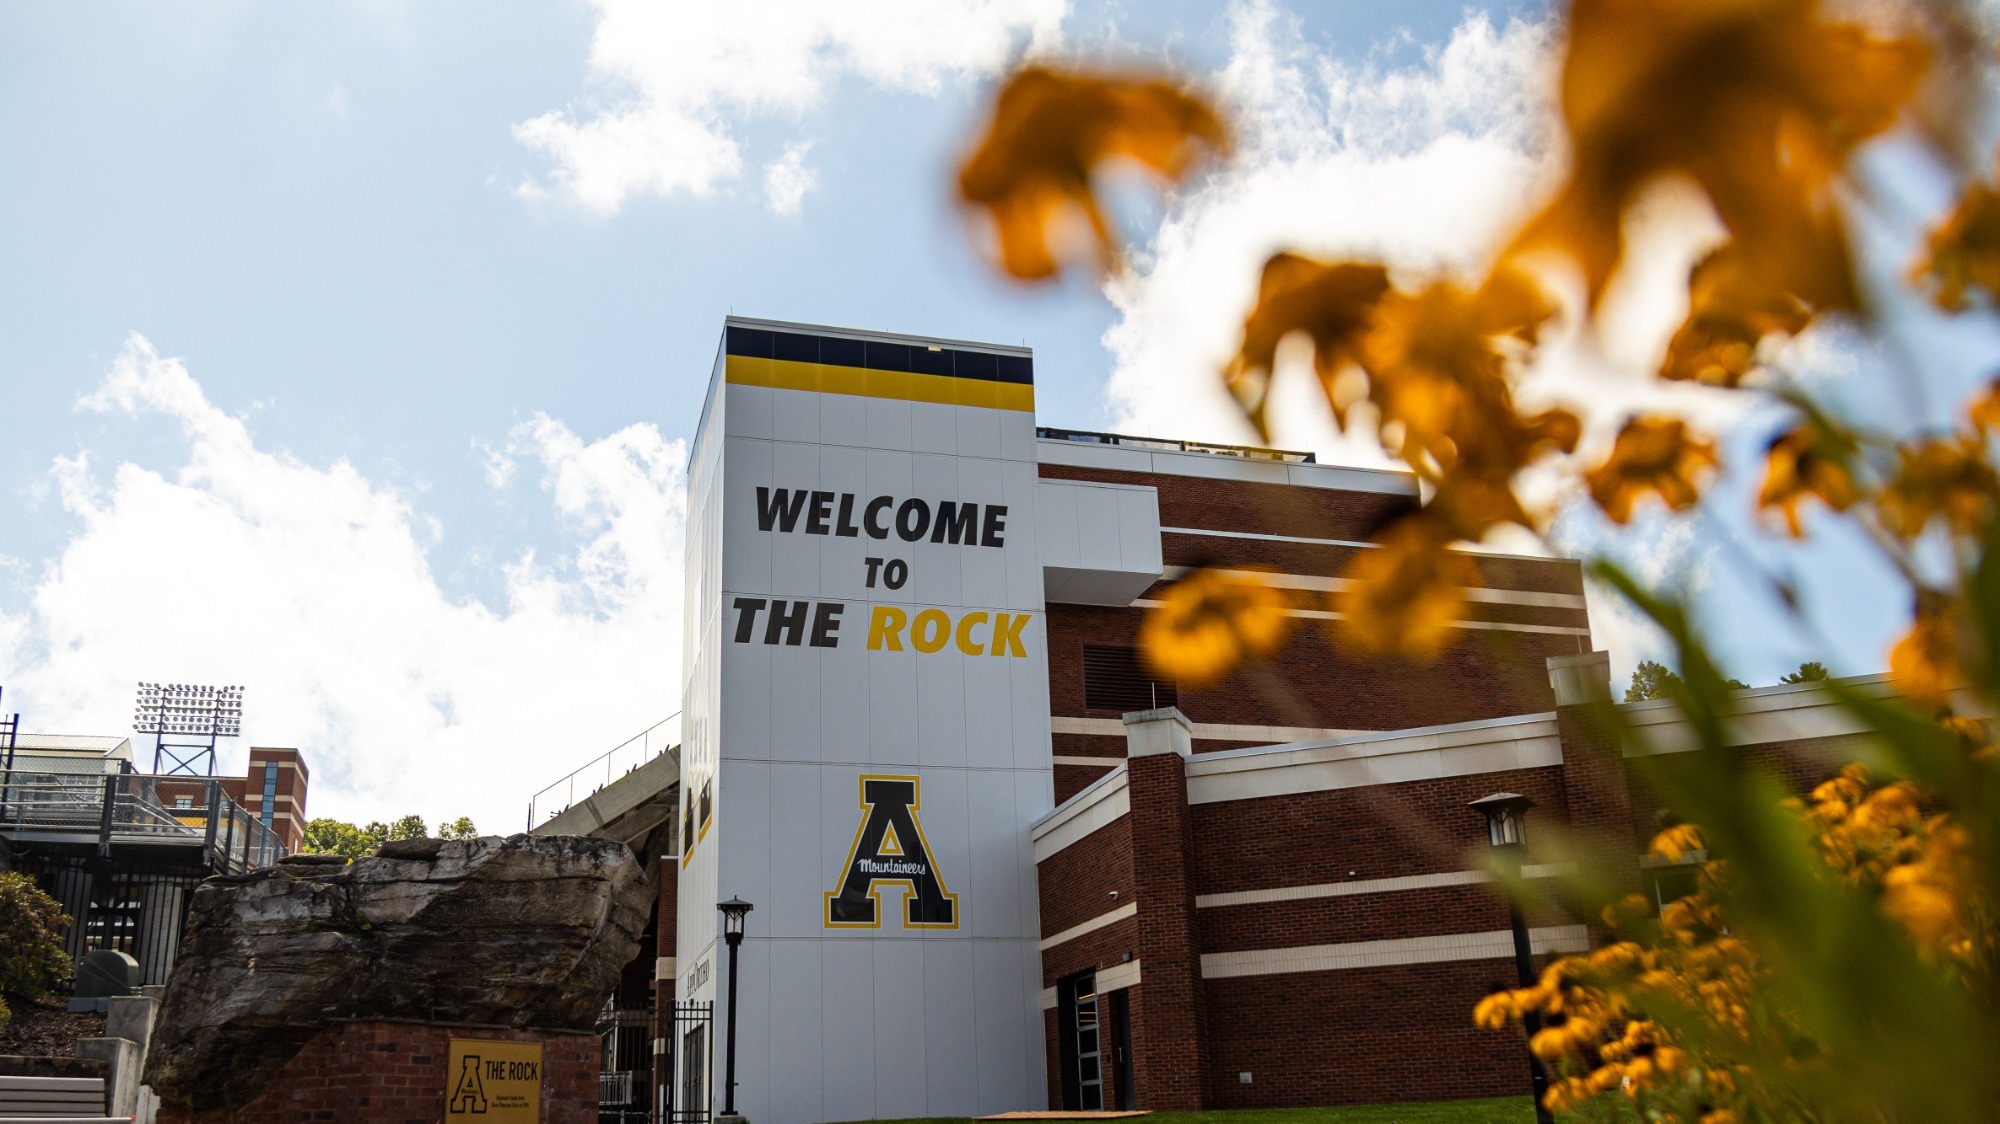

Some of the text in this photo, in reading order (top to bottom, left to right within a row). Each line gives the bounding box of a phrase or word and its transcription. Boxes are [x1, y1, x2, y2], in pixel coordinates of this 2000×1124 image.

[756, 487, 1008, 548] WELCOME
[864, 557, 908, 590] TO
[733, 598, 1032, 658] THE ROCK
[823, 774, 960, 930] A
[857, 858, 926, 875] Mountaineers
[485, 1060, 539, 1081] THE ROCK
